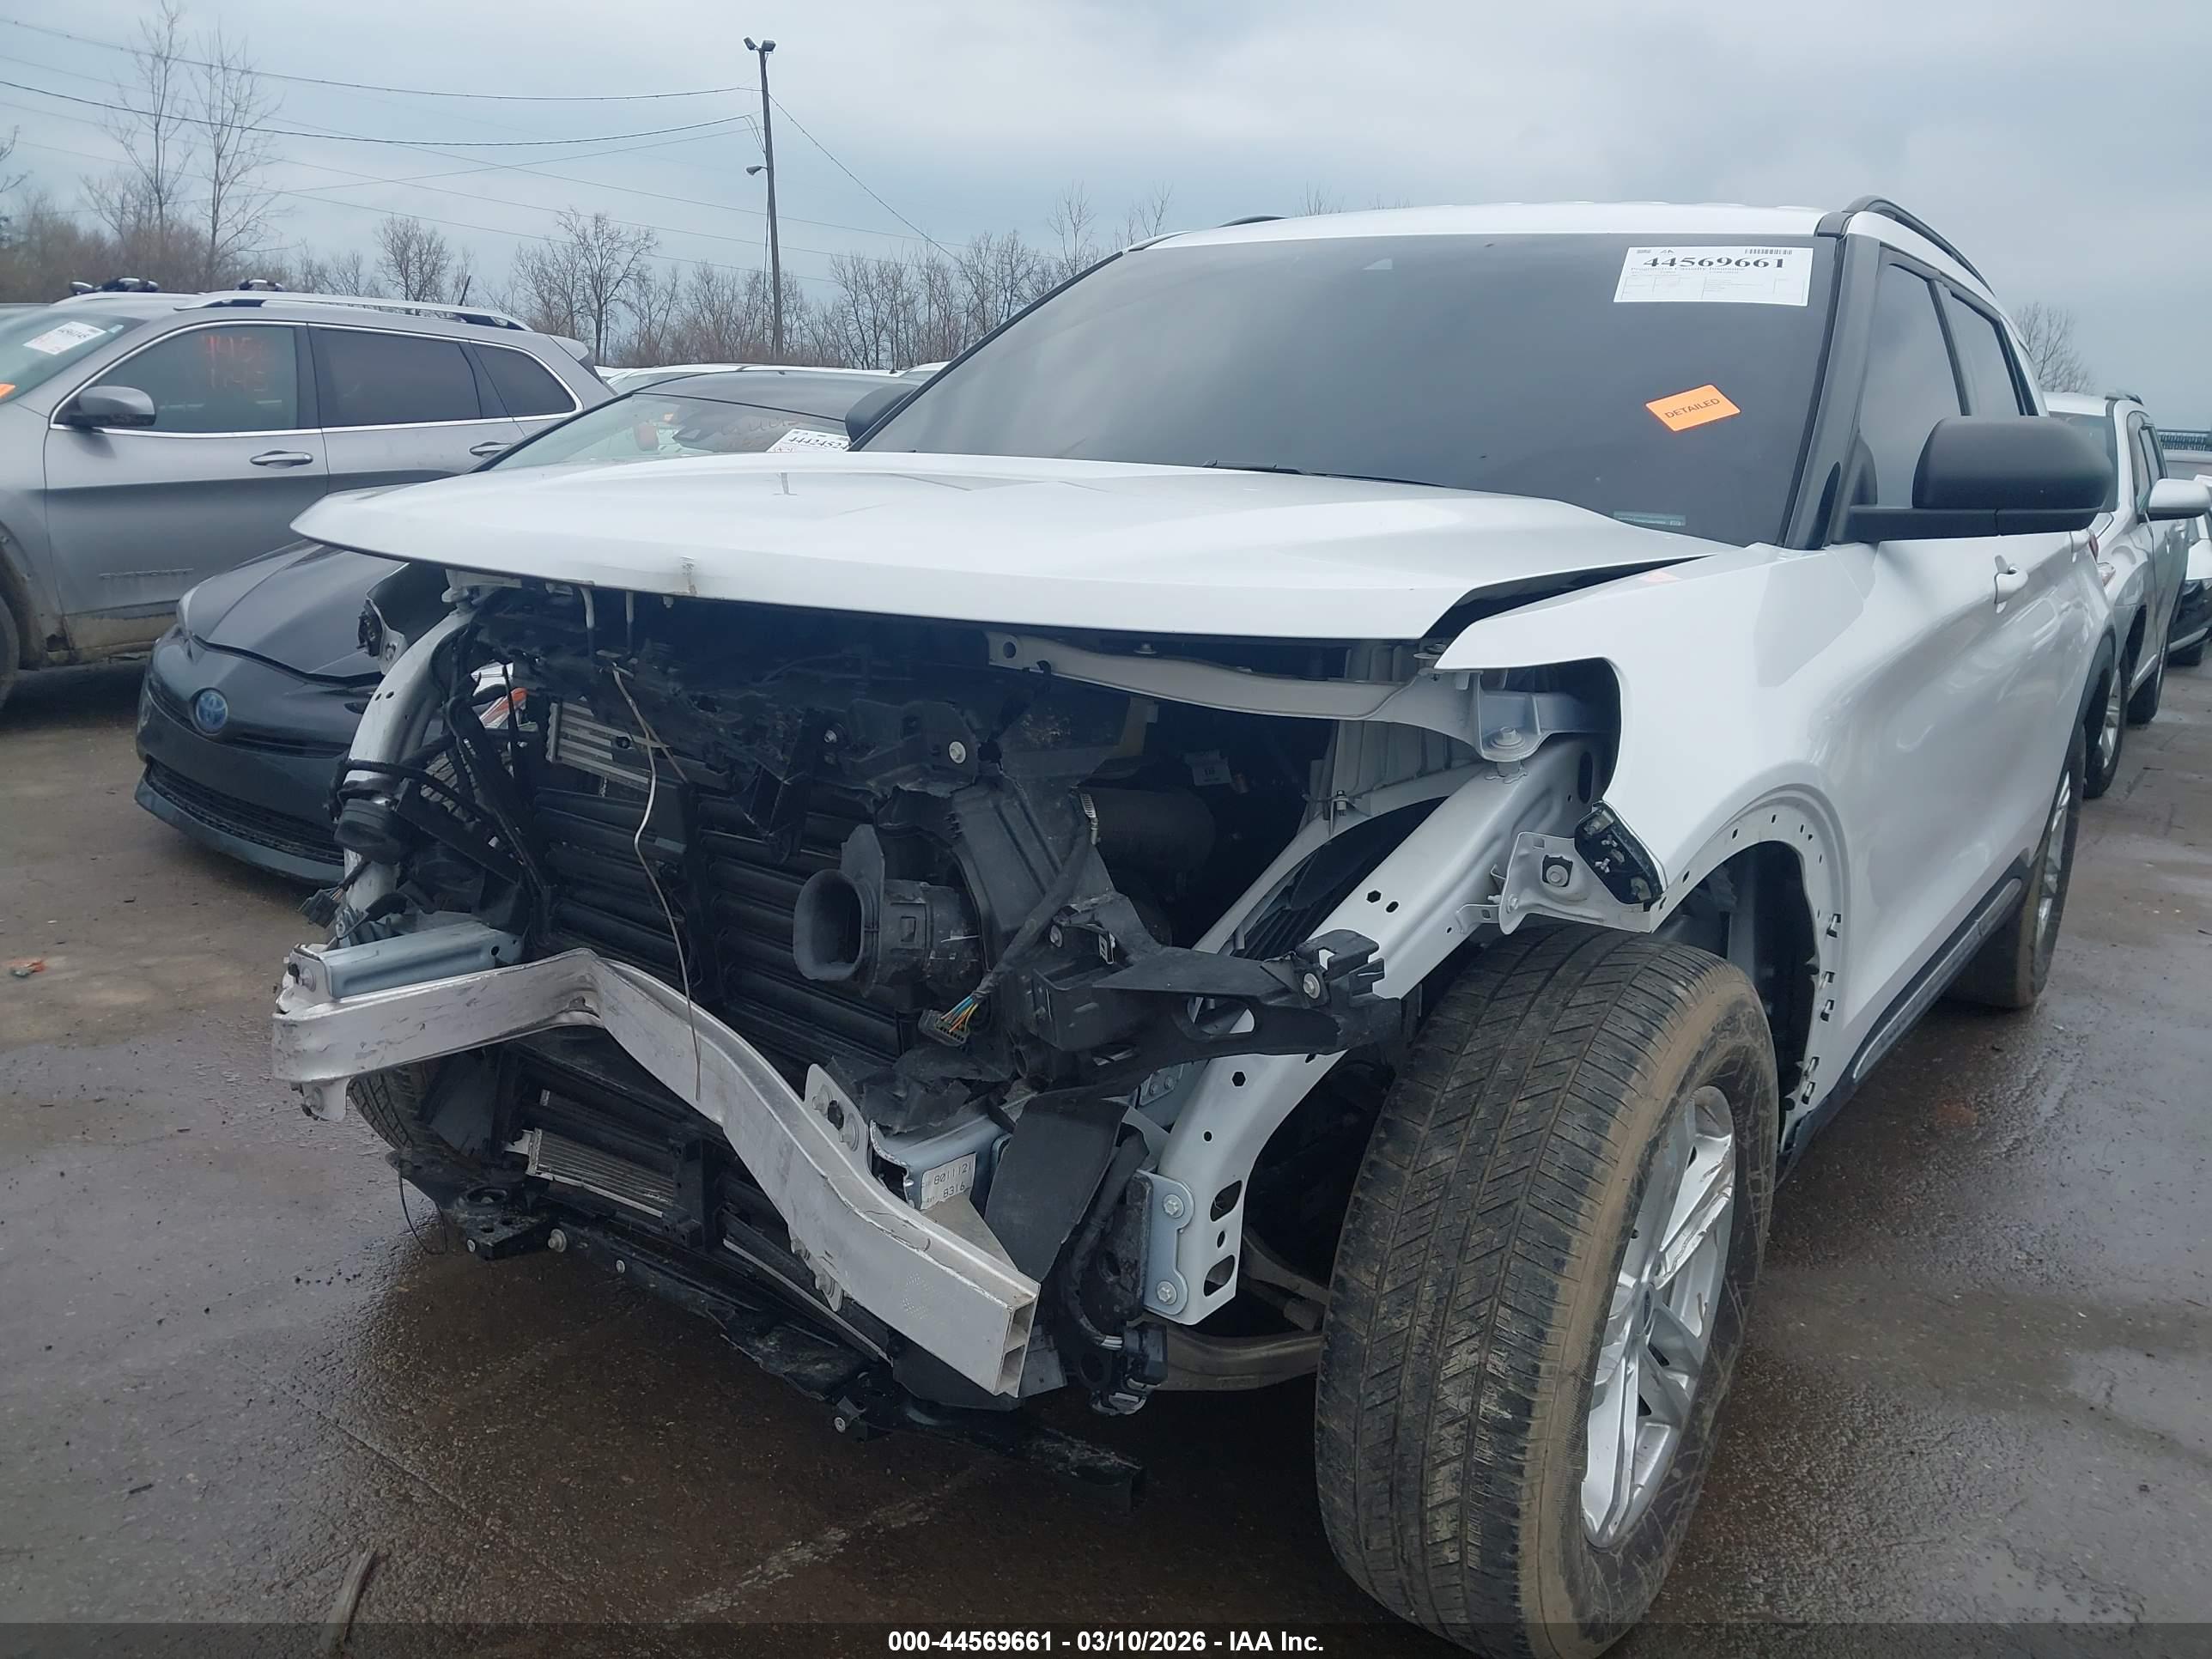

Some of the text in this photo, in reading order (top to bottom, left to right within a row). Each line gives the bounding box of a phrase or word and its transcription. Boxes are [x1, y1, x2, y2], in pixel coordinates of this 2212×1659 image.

[1643, 257, 1784, 268] 44569661
[1664, 398, 1721, 419] DETAILED
[933, 1161, 971, 1185] 8011121
[943, 1181, 965, 1198] 8316
